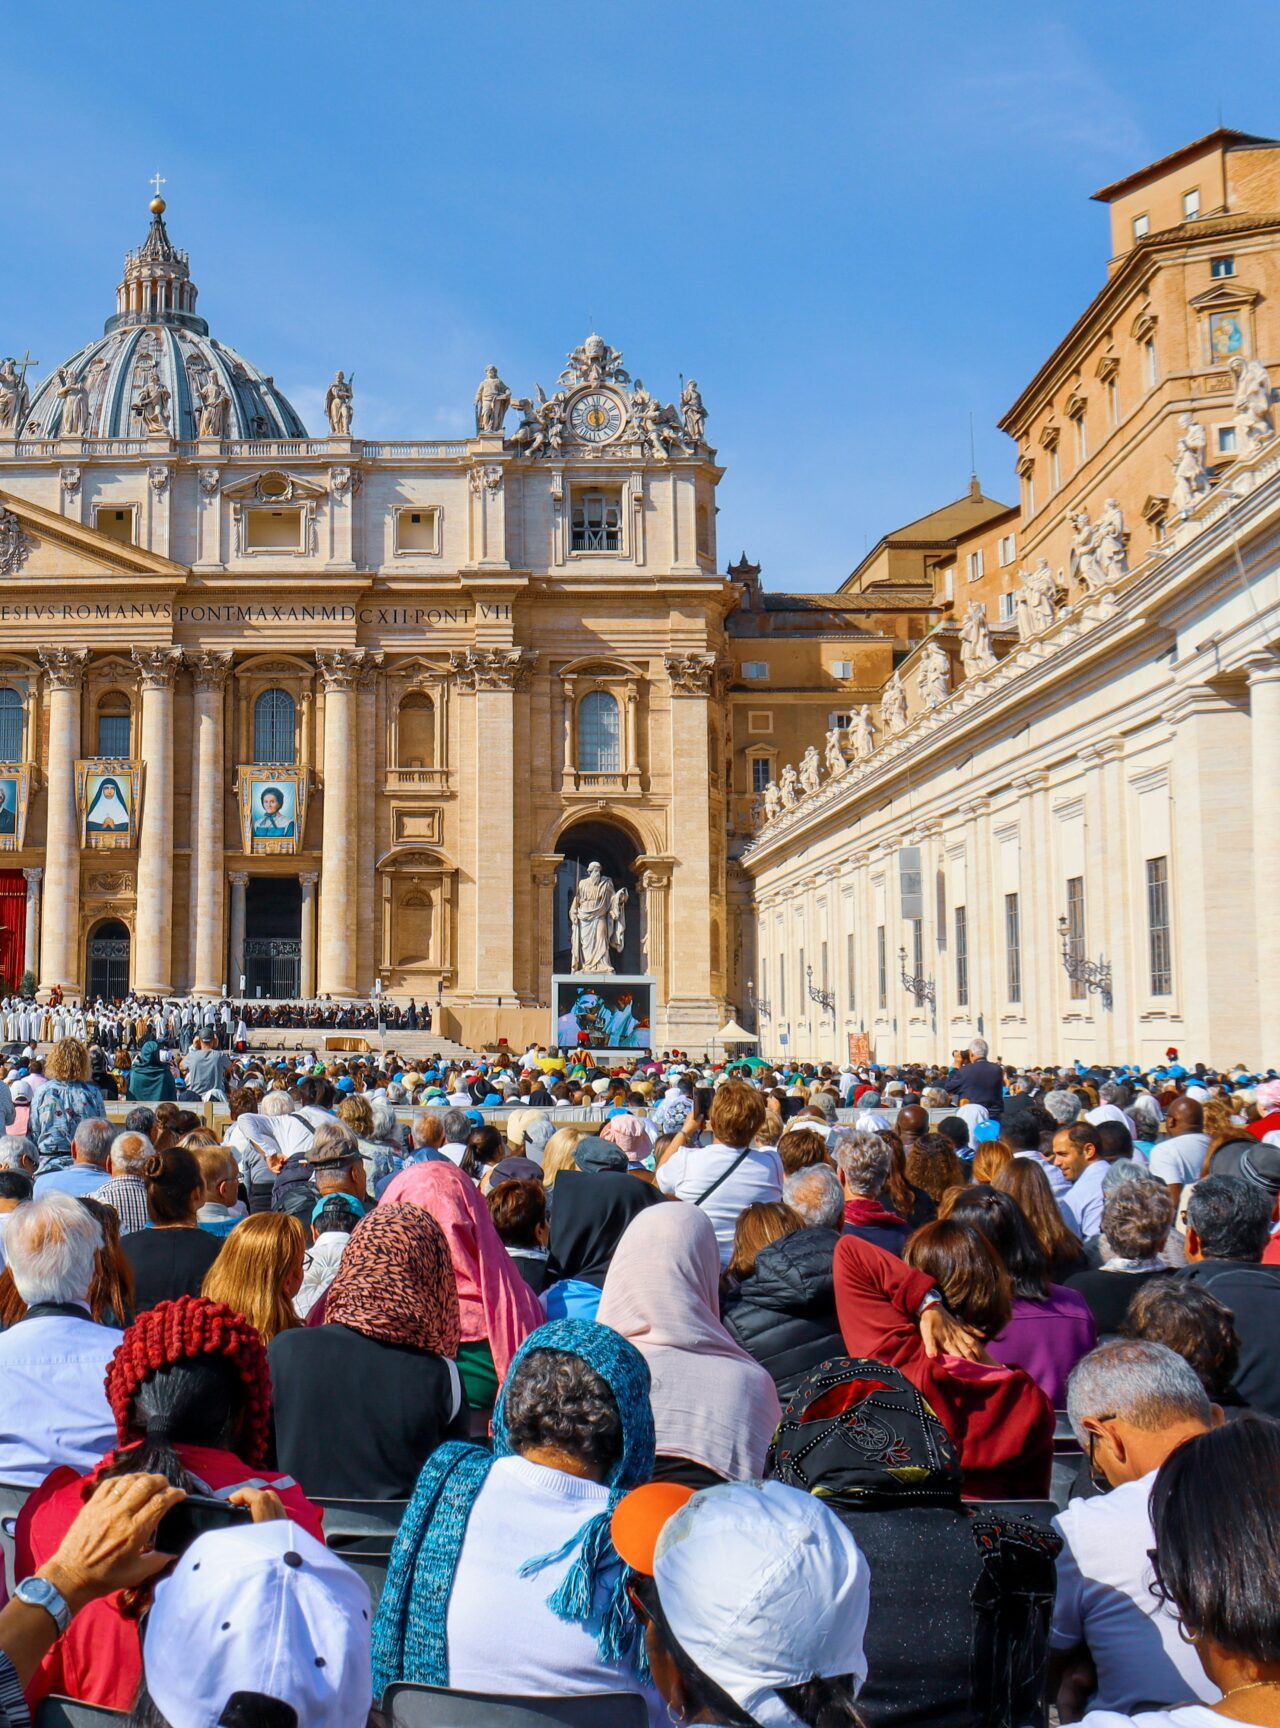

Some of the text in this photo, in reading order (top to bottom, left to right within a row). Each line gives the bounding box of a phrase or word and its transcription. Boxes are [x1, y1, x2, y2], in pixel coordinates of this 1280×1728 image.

[63, 603, 171, 620] ROMANVS
[179, 606, 234, 622] PONT
[236, 606, 283, 622] MAX
[286, 606, 316, 621] AN
[415, 608, 472, 624] PONT
[480, 604, 510, 620] VII
